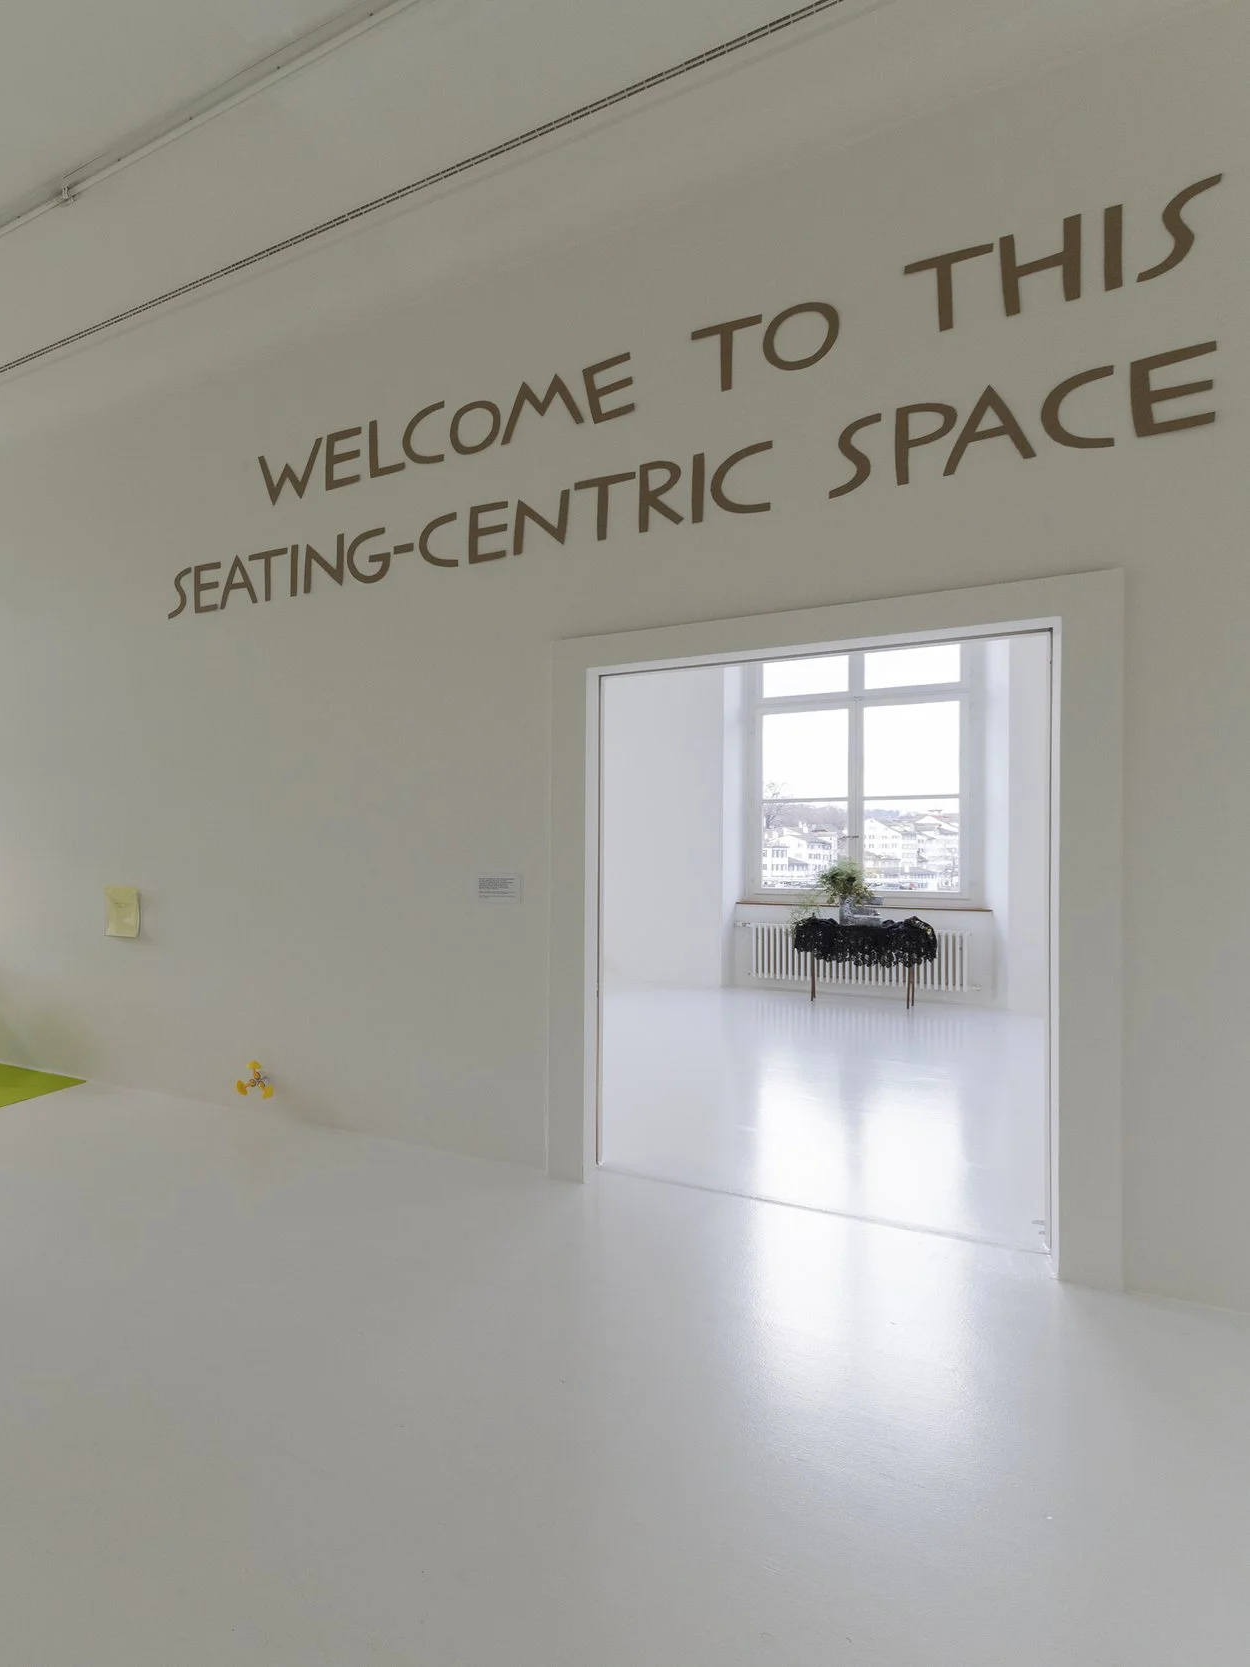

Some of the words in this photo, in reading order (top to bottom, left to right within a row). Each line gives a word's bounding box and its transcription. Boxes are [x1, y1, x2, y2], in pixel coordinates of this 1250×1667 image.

[167, 439, 773, 620] SEATING-CENTRIC
[828, 340, 1218, 500] SPACE
[257, 351, 637, 506] WELCOME
[690, 301, 841, 393] TO
[903, 173, 1224, 333] THIS
